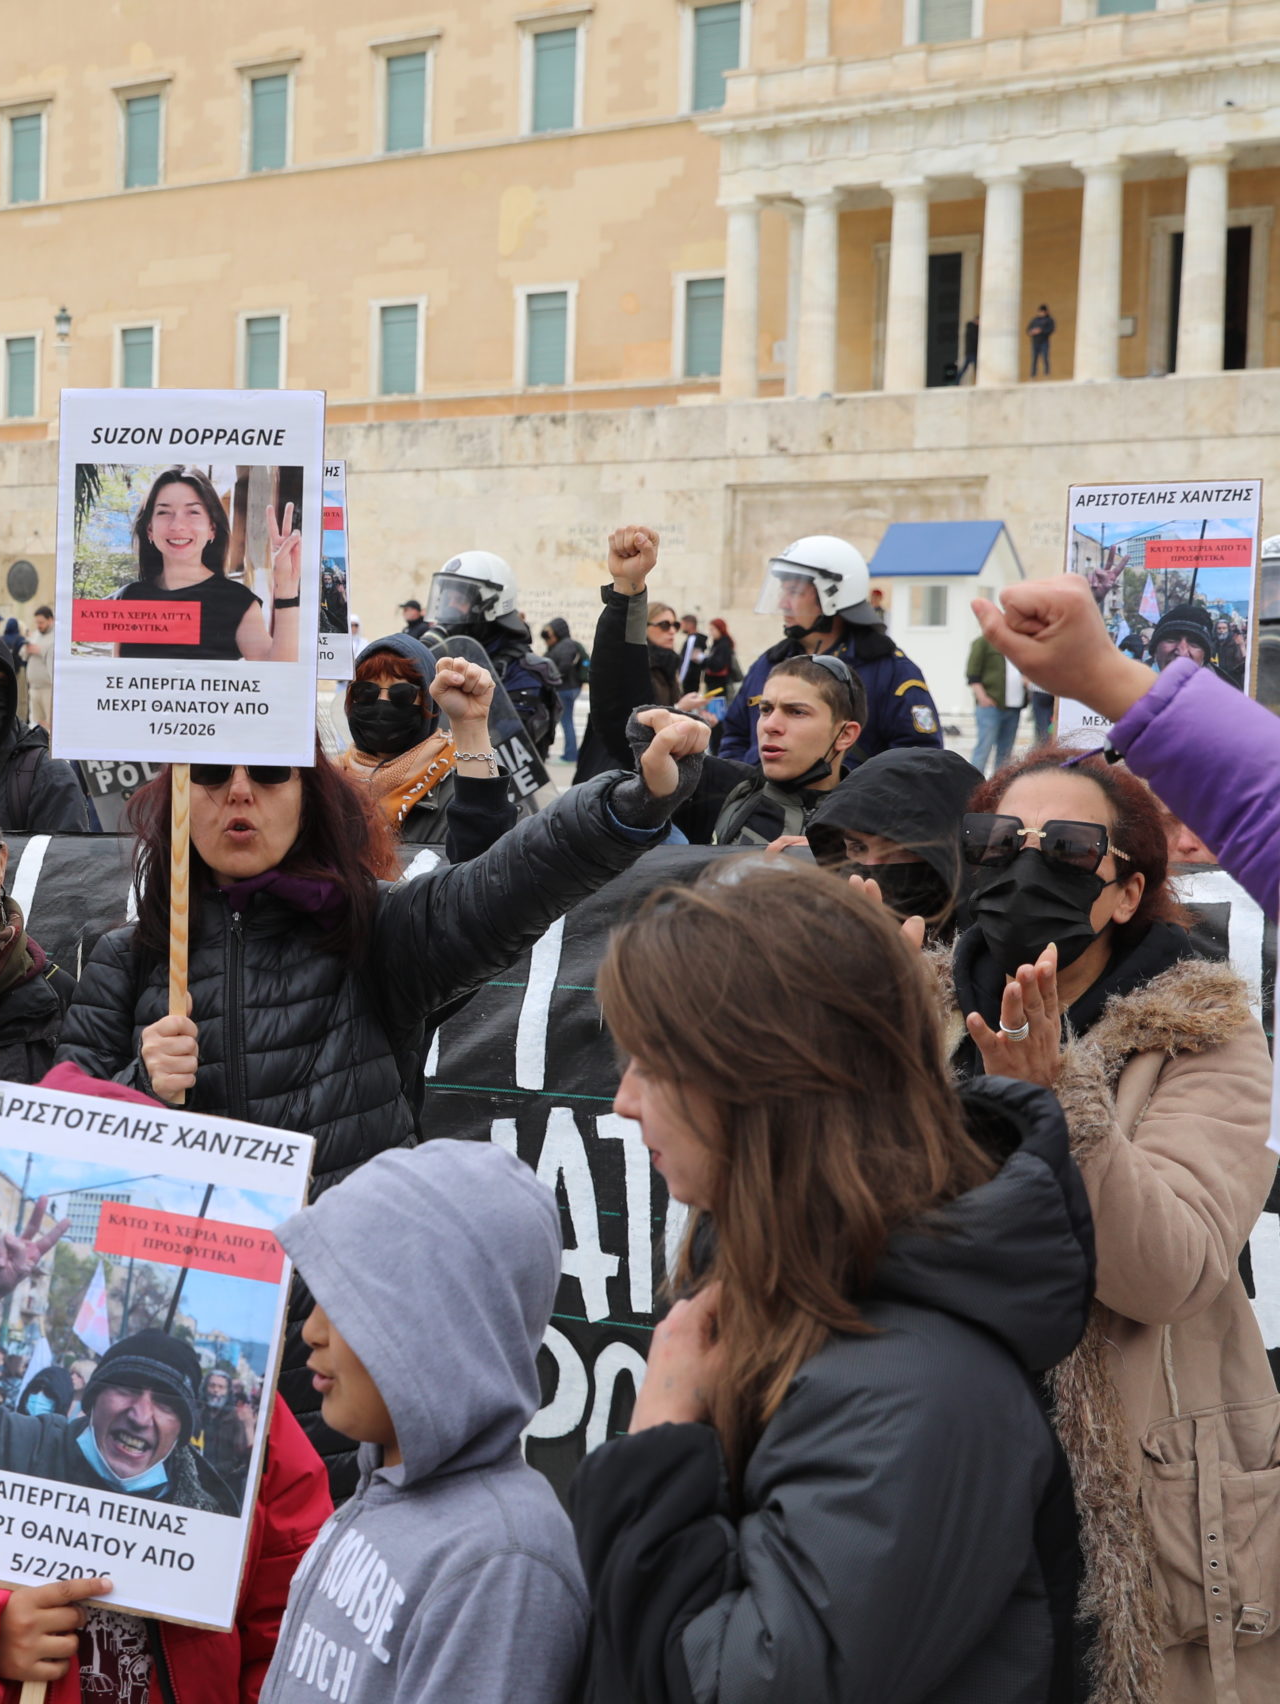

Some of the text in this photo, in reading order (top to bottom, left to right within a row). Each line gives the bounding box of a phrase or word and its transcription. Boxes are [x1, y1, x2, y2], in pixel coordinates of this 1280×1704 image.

[91, 427, 286, 446] SUZON DOPPAGNE
[1076, 488, 1253, 507] ΑΡΙΣΤΟΤΕΛΗΣ ΧΑΝΤΖΗΣ
[81, 610, 109, 619] ΚΑΤΩ
[111, 611, 125, 619] ΤΑ
[127, 611, 158, 620] ΧΕΡΙΑ
[103, 623, 169, 632] ΠΡΟΣΦΥΓΙΚΑ
[106, 676, 261, 693] ΣΕ ΑΠΕΡΓΙΑ ΠΕΙΝΑΣ
[96, 698, 269, 716] ΜΕΧΡΙ ΘΑΝΑΤΟΥ ΑΠΟ
[148, 722, 216, 736] 1/5/2026
[171, 1126, 300, 1167] ΧΑΝΤΖΗΣ
[108, 1213, 278, 1253] ΚΑΤΩ ΤΑ ΧΕΡΙΑ ΑΠΟ ΤΑ
[142, 1237, 237, 1265] ΠΡΟΣΦΥΓΙΚΑ
[98, 1500, 188, 1536] ΠΕΙΝΑΣ
[21, 1520, 137, 1560] ΘΑΝΑΤΟΥ
[141, 1545, 195, 1572] ΑΠΟ
[288, 1622, 357, 1703] FITCH
